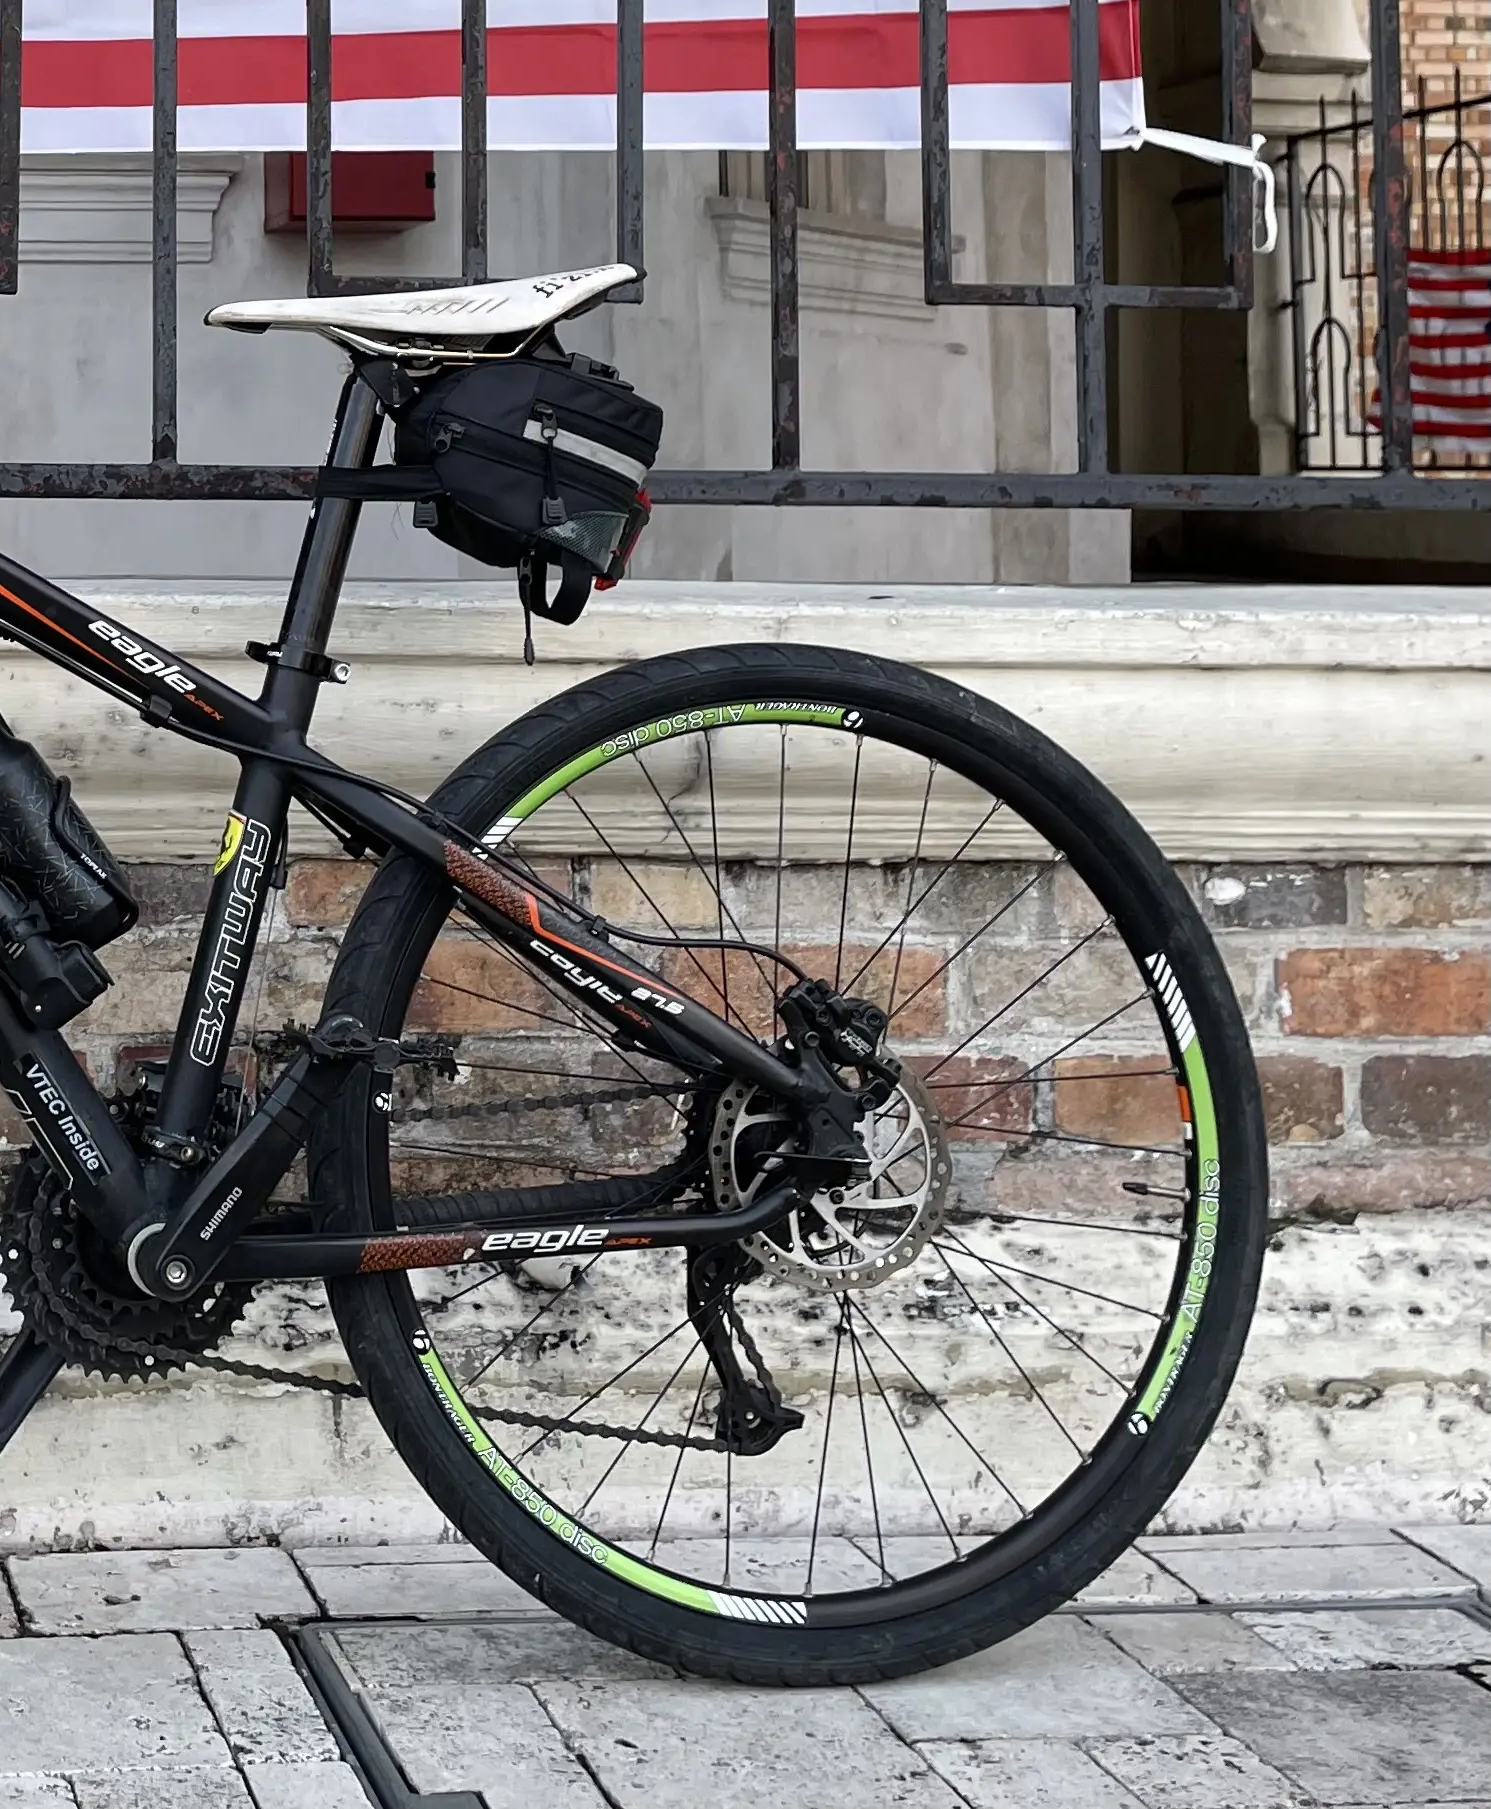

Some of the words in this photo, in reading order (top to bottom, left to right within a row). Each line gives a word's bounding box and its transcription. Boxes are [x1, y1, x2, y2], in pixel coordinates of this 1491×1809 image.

[88, 620, 197, 694] eagle
[600, 724, 650, 758] disc
[656, 703, 746, 739] AT-850
[189, 818, 272, 1067] EXITWAY
[25, 1063, 67, 1117] VTEC
[58, 1113, 101, 1173] Inside
[199, 1185, 243, 1242] SHIMANO
[1198, 1158, 1221, 1216] disc
[481, 1224, 610, 1253] eagle
[1179, 1221, 1219, 1324] AT-850
[478, 1446, 560, 1527] AT-850
[561, 1514, 609, 1566] disc
